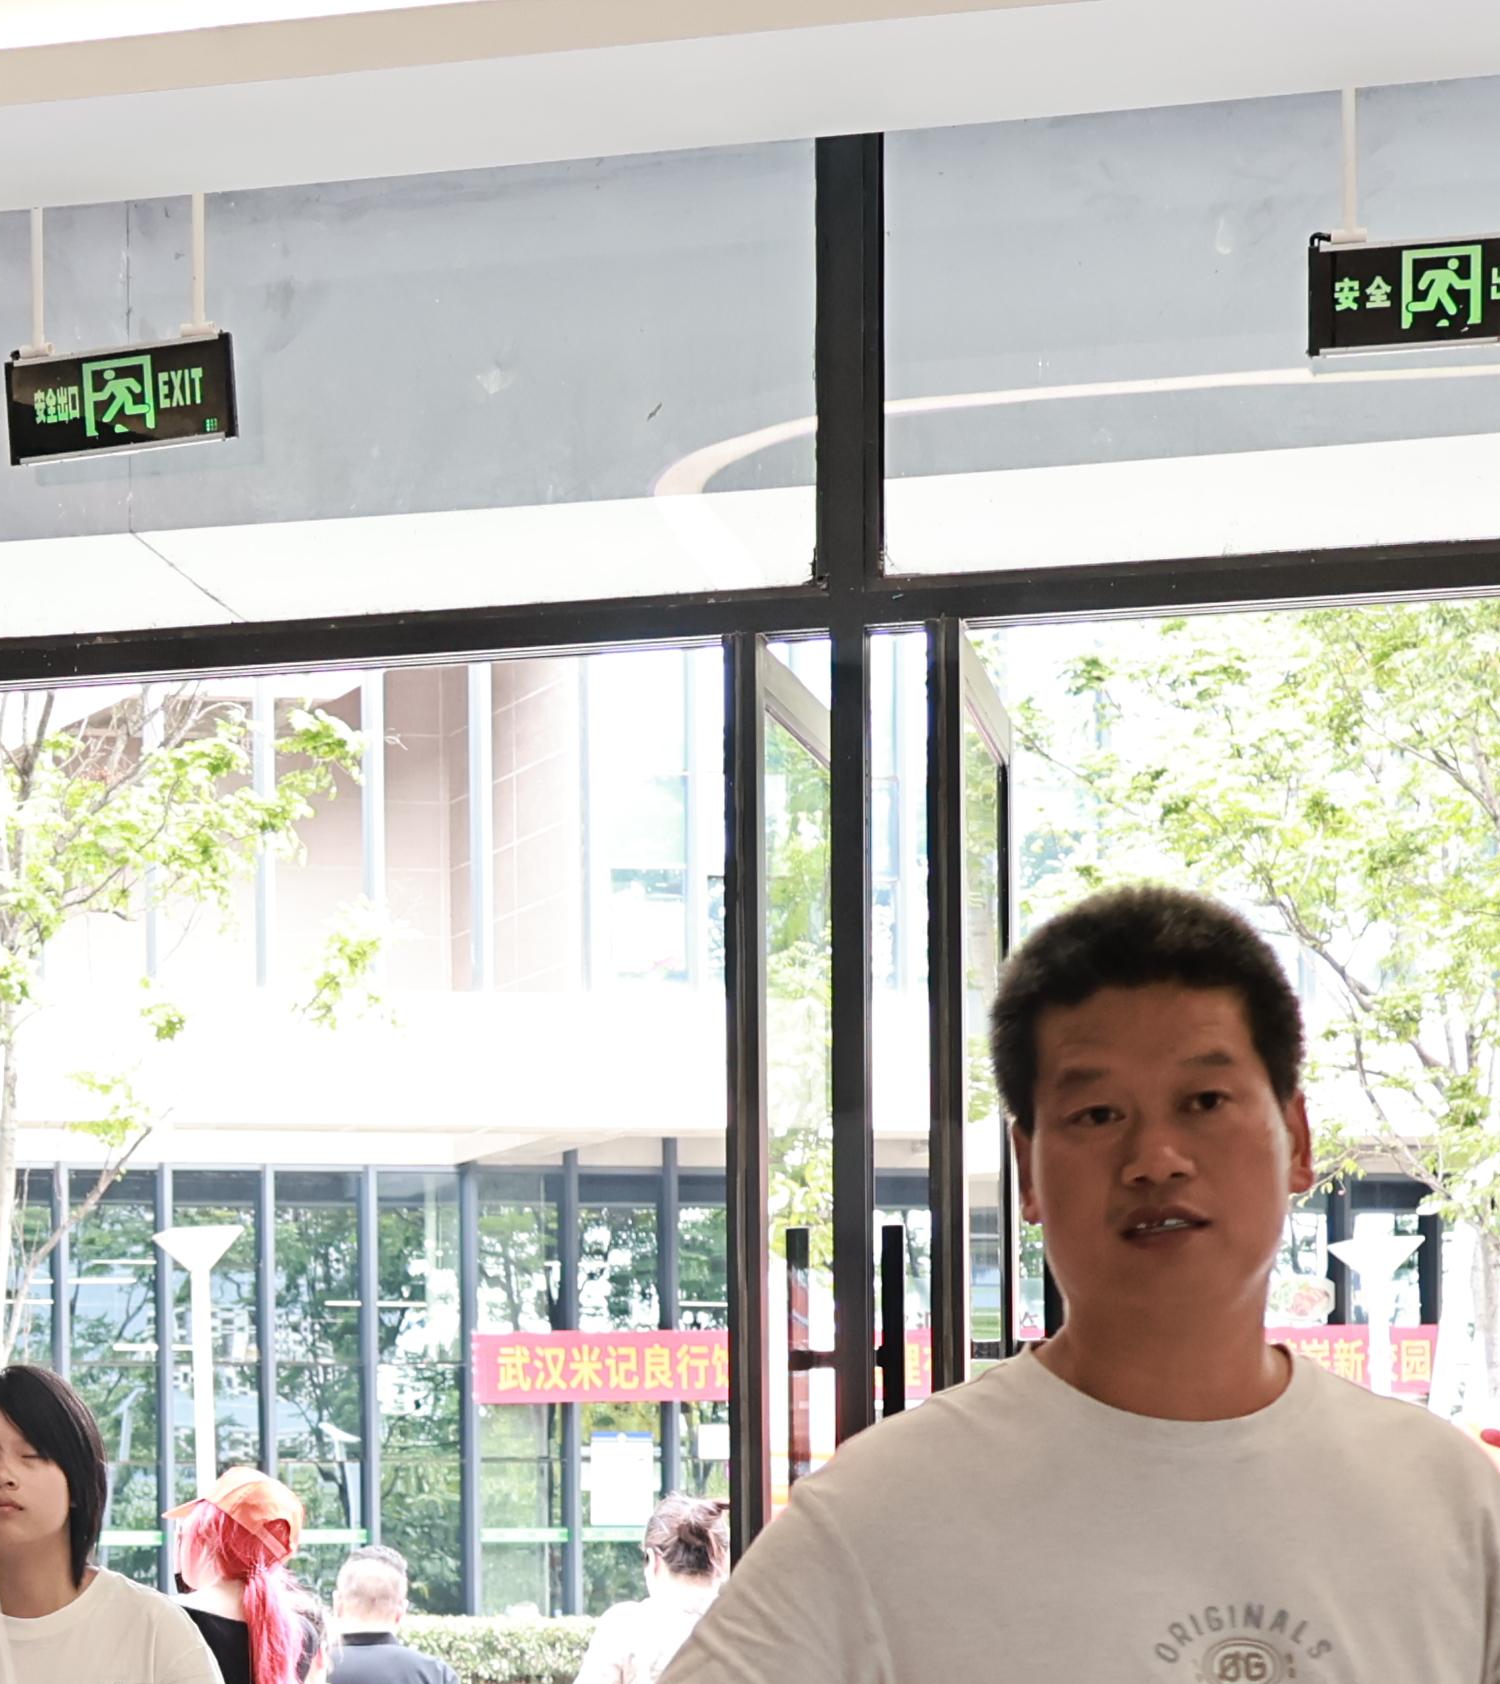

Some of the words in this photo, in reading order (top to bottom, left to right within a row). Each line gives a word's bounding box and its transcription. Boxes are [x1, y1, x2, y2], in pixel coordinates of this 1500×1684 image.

[1334, 276, 1392, 311] 安全
[34, 386, 81, 424] 安全出口
[158, 367, 203, 408] EXIT
[1154, 1603, 1333, 1664] ORIGINALS
